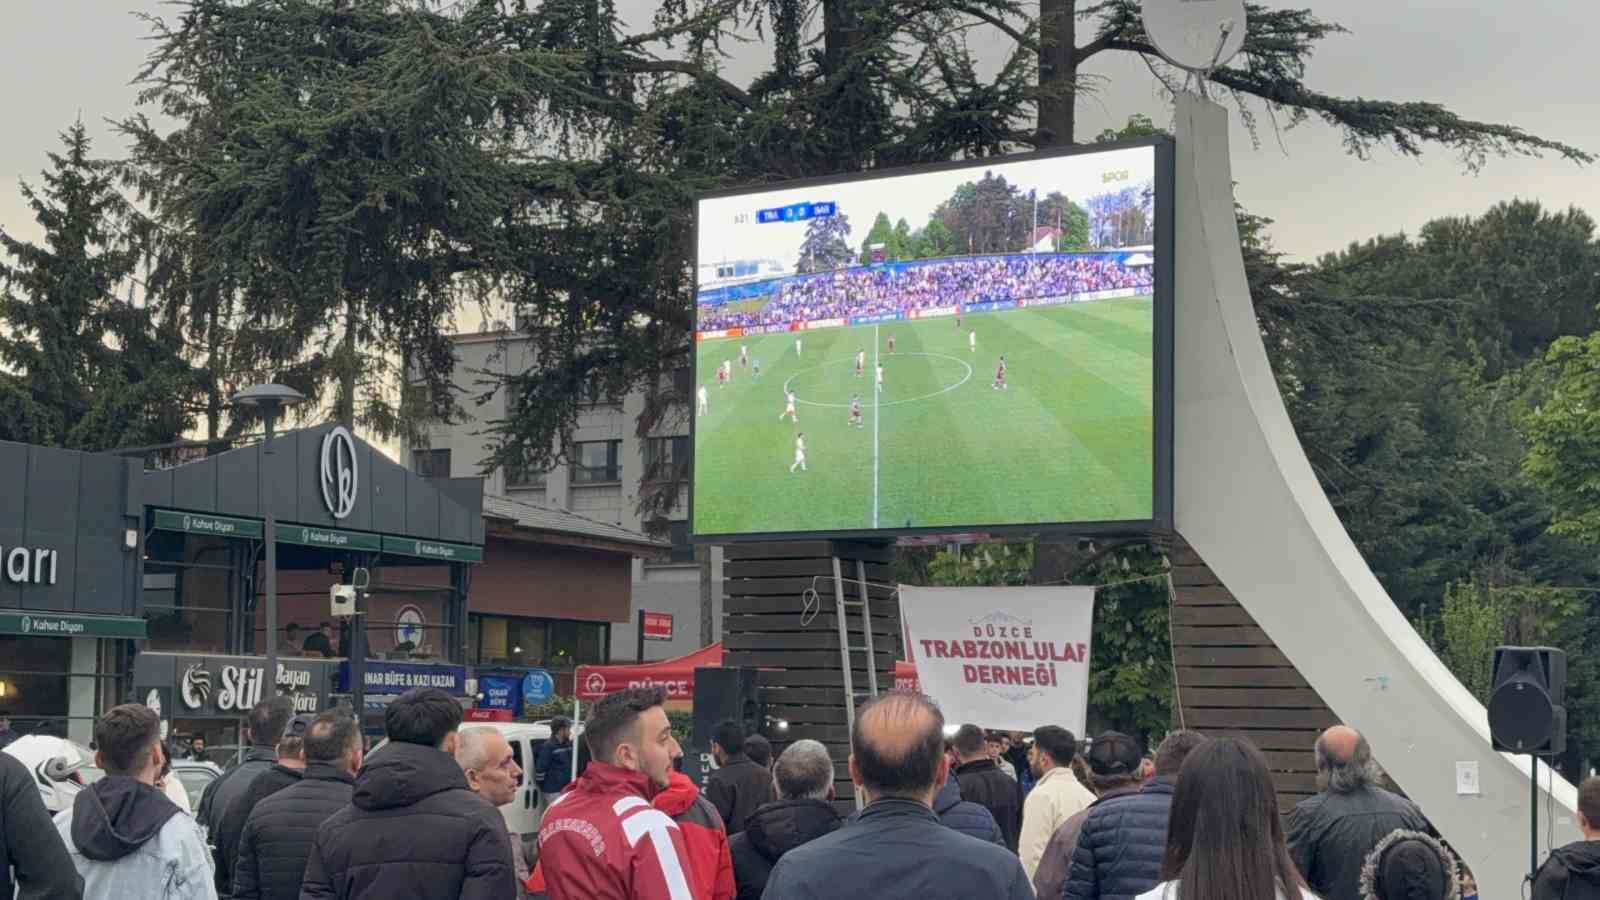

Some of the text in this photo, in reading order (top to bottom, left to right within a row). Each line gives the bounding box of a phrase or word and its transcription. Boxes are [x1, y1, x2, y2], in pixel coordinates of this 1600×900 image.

[973, 624, 1033, 638] DÜZCE
[276, 663, 310, 690] Bayan
[385, 670, 405, 686] BÜFE
[406, 674, 412, 686] &
[413, 674, 430, 687] KAZI
[431, 675, 455, 688] KAZAN
[963, 663, 1058, 687] DERNEĞİ
[217, 664, 265, 711] Stil
